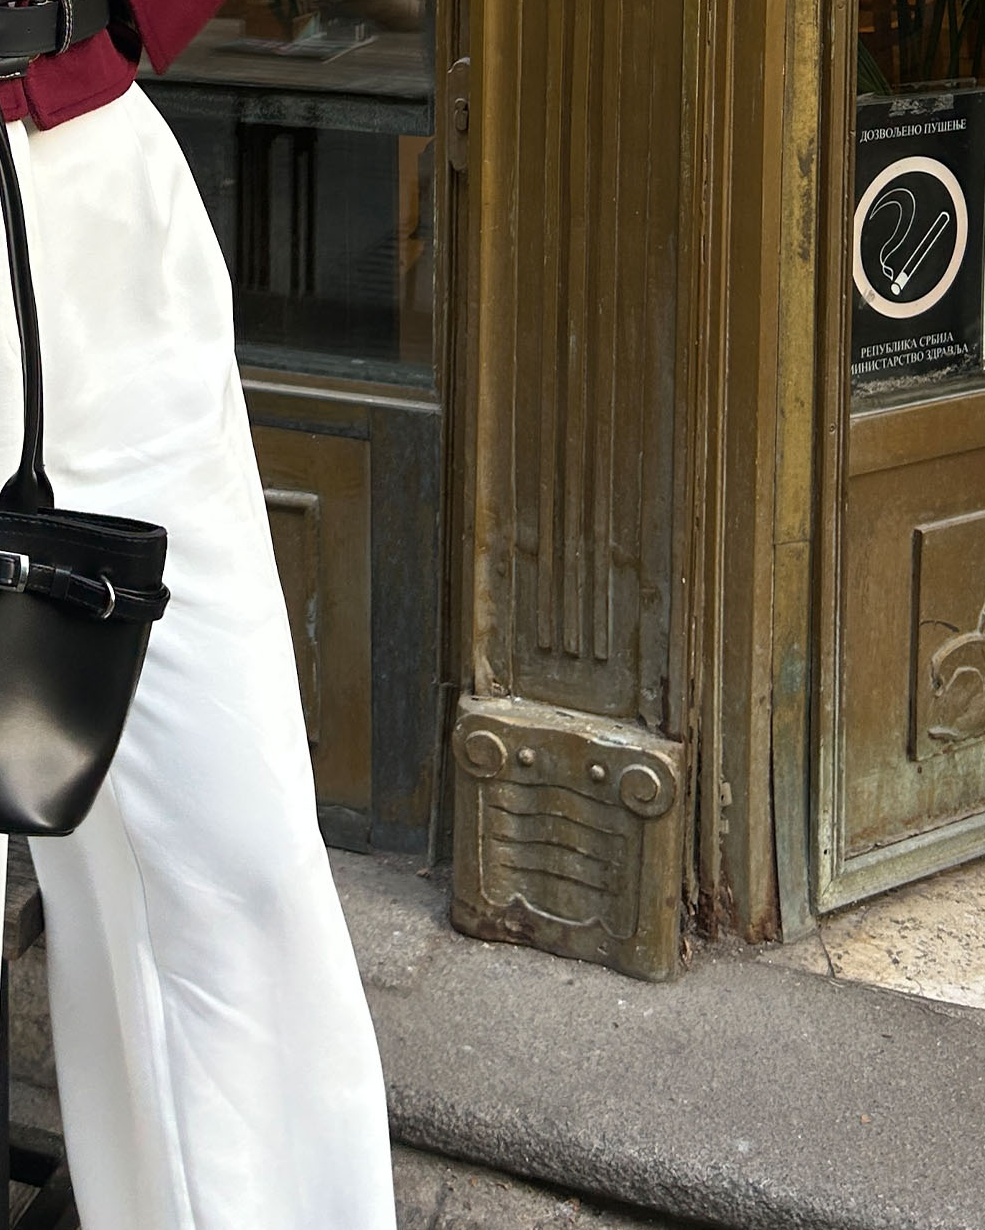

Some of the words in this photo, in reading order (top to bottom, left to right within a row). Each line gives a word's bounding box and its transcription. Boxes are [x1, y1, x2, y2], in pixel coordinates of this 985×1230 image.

[859, 124, 923, 143] ДОЗВОЉЕНО
[924, 118, 967, 134] ПУШЕЊЕ
[860, 338, 918, 359] РЕПУБЛИКА
[919, 331, 955, 348] СРБИЈА
[926, 343, 969, 361] ЗДРАВЉА
